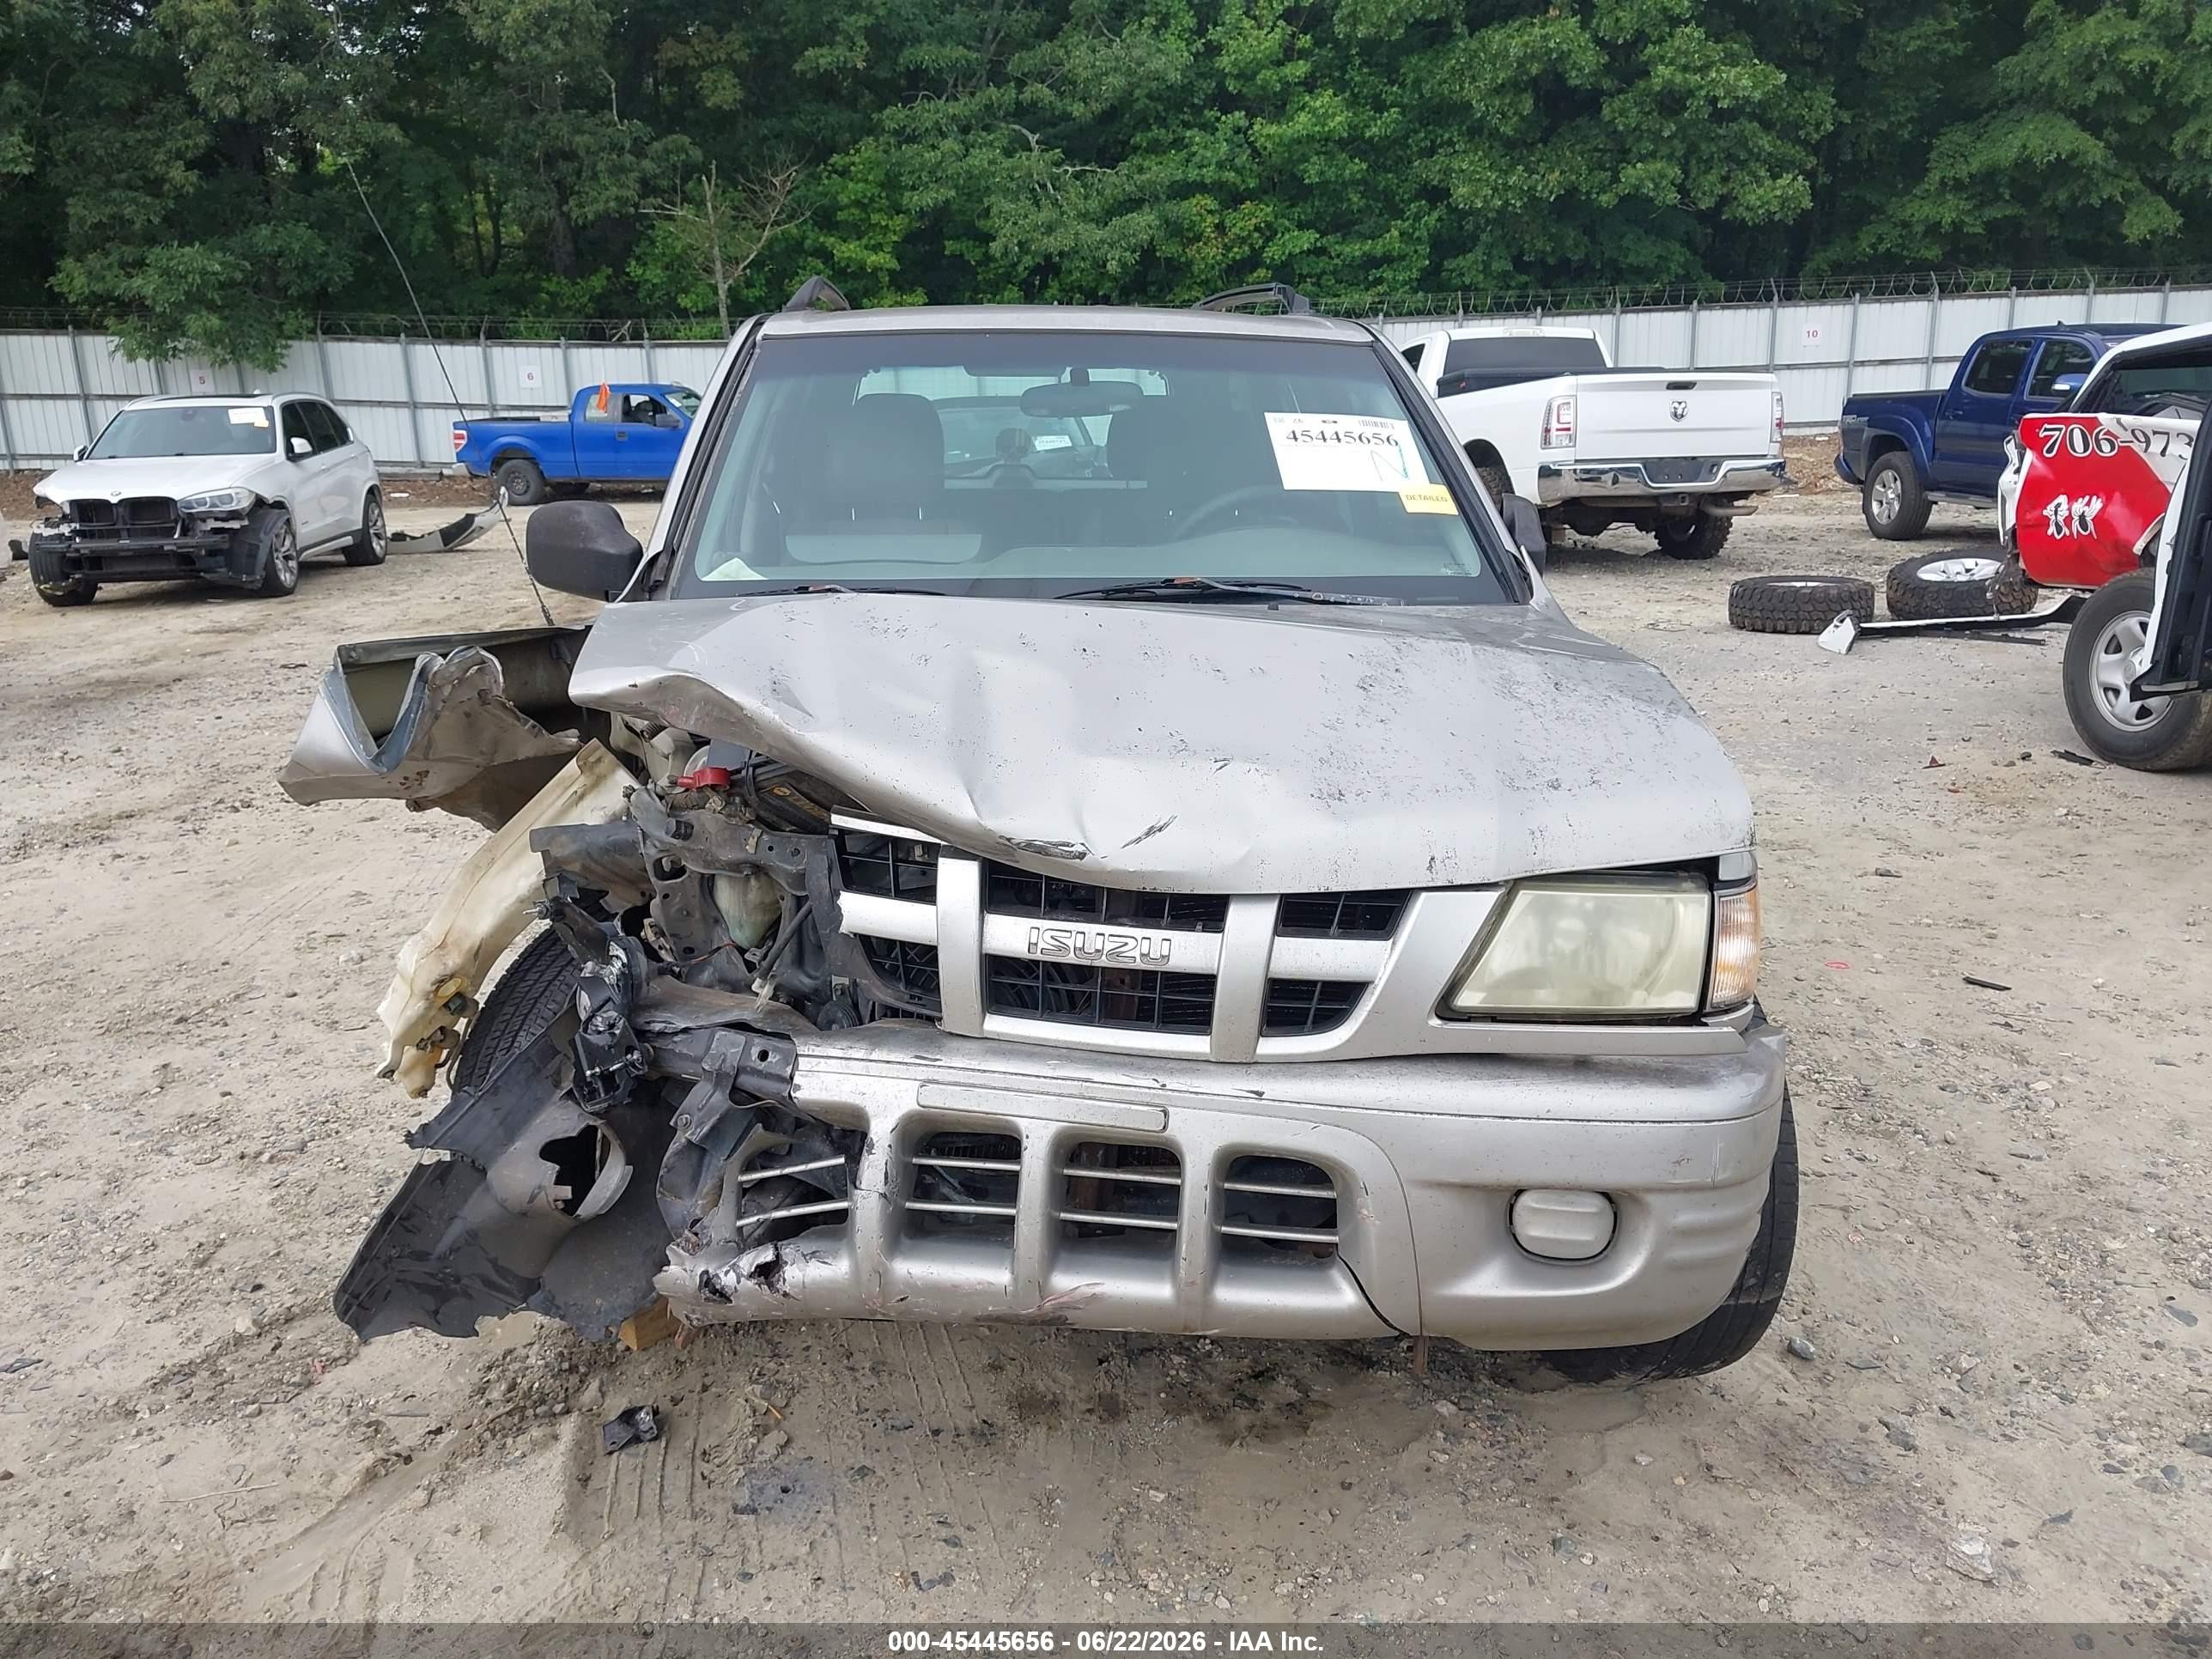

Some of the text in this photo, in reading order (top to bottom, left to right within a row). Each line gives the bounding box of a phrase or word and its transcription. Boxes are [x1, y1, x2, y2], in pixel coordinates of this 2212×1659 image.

[1807, 330, 1818, 338] 10
[527, 372, 534, 380] 6
[198, 376, 206, 385] 5
[1286, 429, 1399, 447] 45445656
[1405, 494, 1449, 502] DETAILED
[1028, 927, 1171, 966] ISUZU
